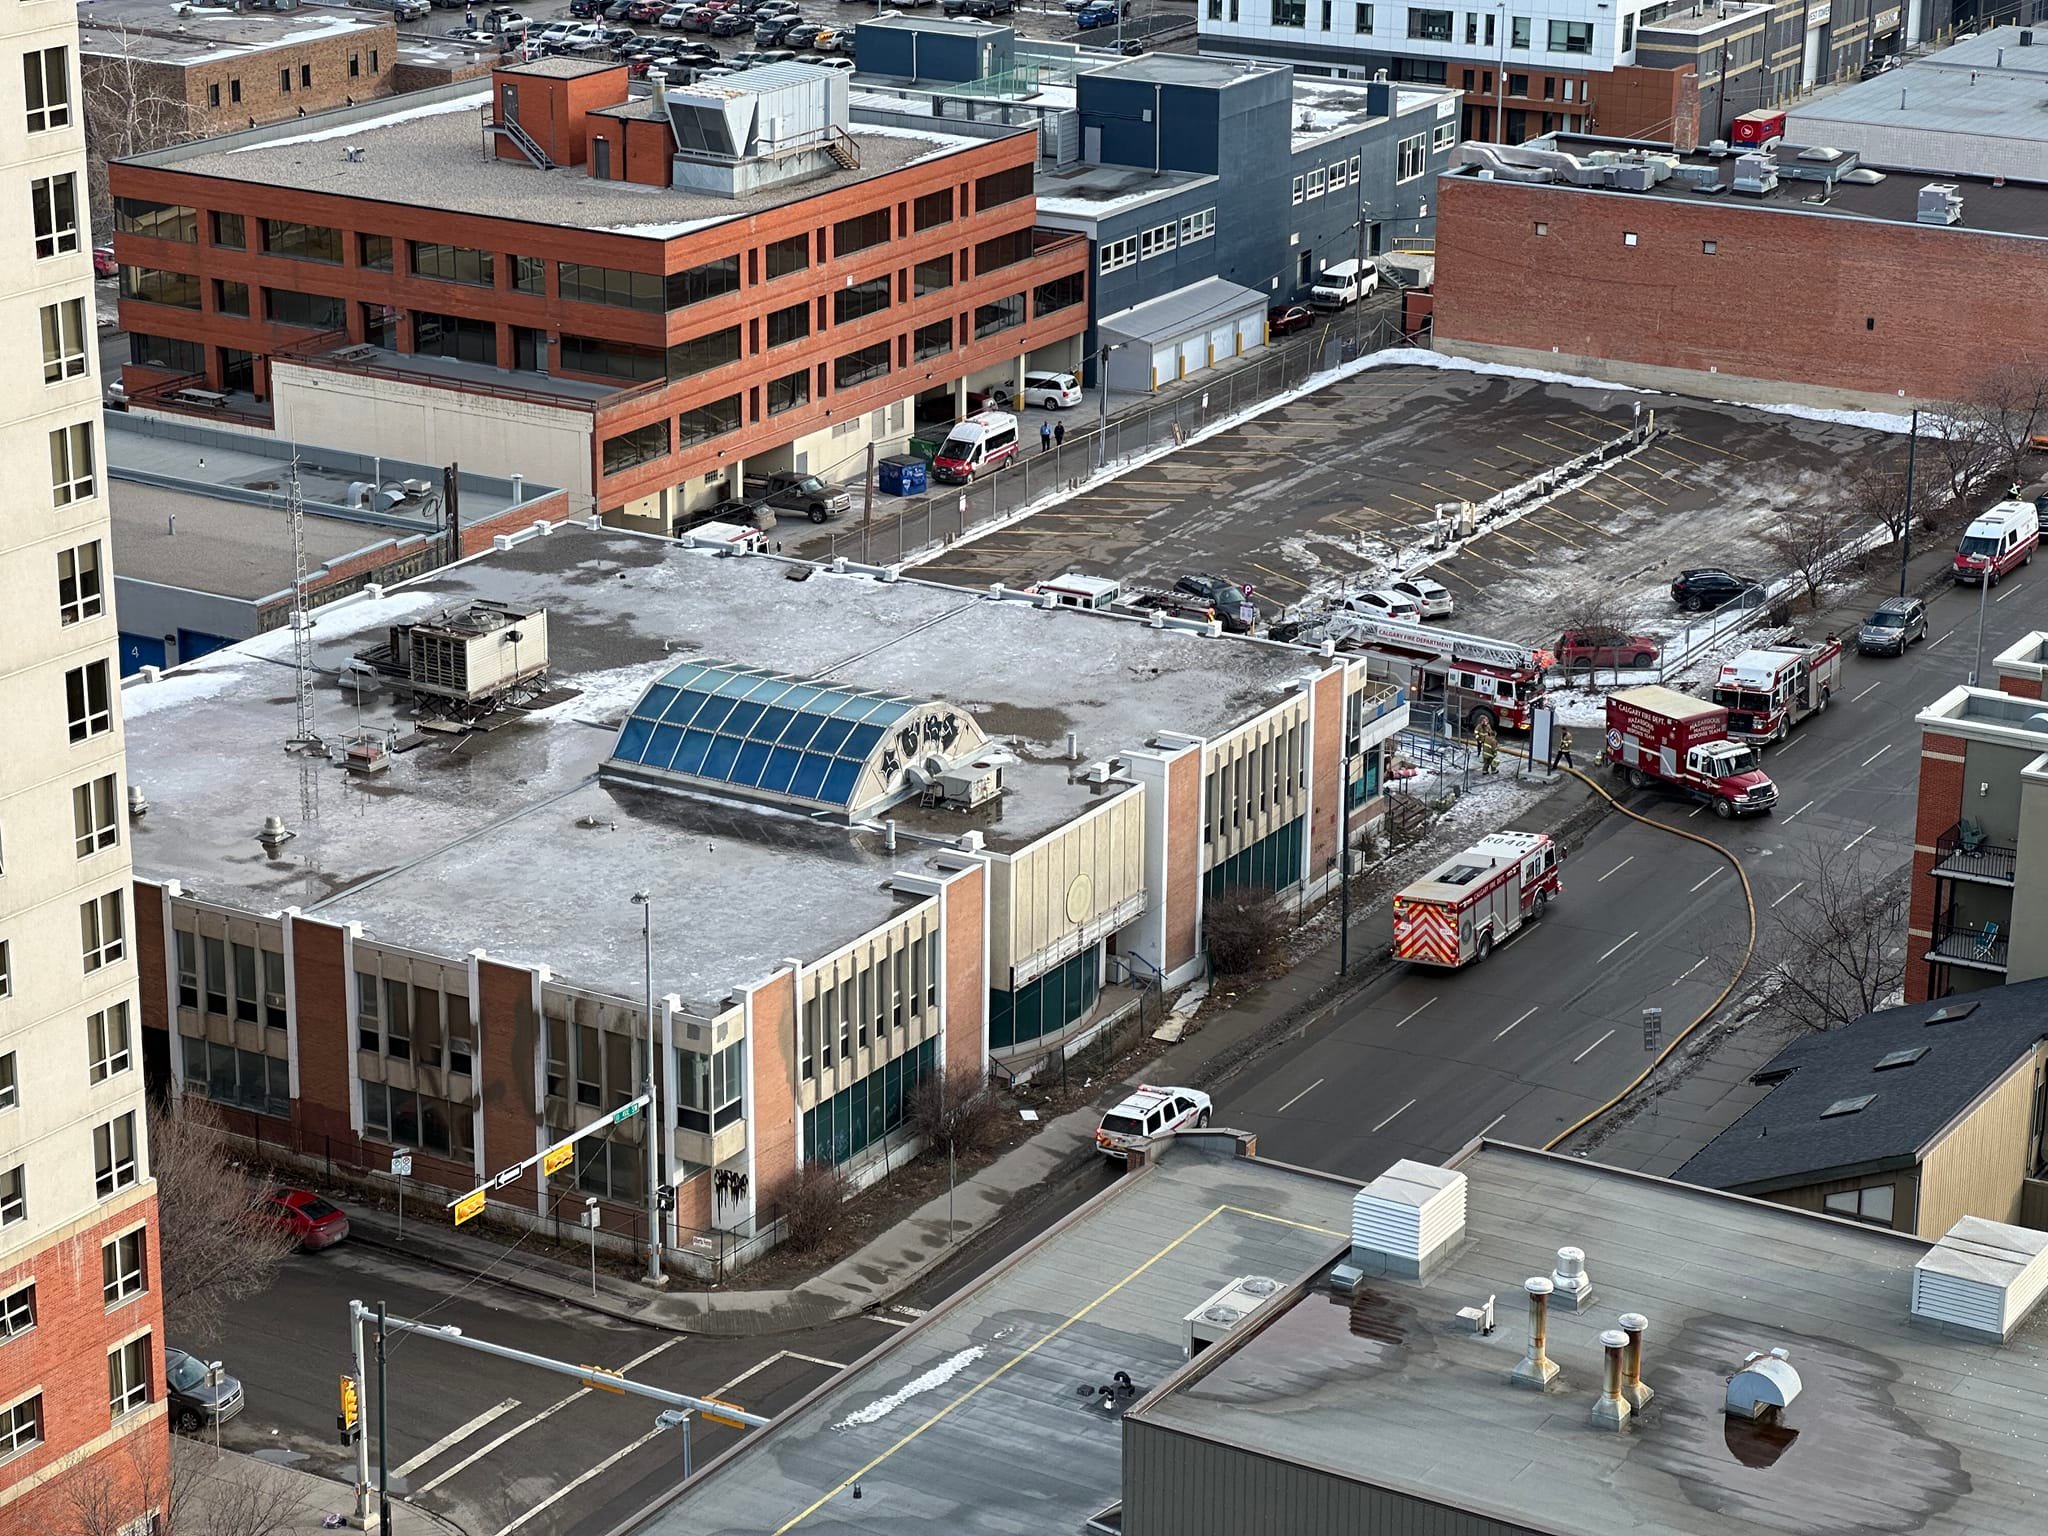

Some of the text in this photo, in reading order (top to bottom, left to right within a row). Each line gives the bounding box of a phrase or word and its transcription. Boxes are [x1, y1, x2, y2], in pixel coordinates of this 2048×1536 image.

[1379, 629, 1452, 649] CALGARY FIRE DEPARTMENT
[131, 646, 140, 659] 4
[1619, 704, 1641, 716] CALGARY
[1642, 712, 1651, 721] FIRE
[1628, 717, 1655, 731] HAZARDOUS
[1690, 717, 1721, 731] HAZARDOUS
[1643, 731, 1655, 740] TEAM
[1688, 727, 1721, 740] RESPONSE TEAM
[1474, 886, 1489, 899] CALGARY
